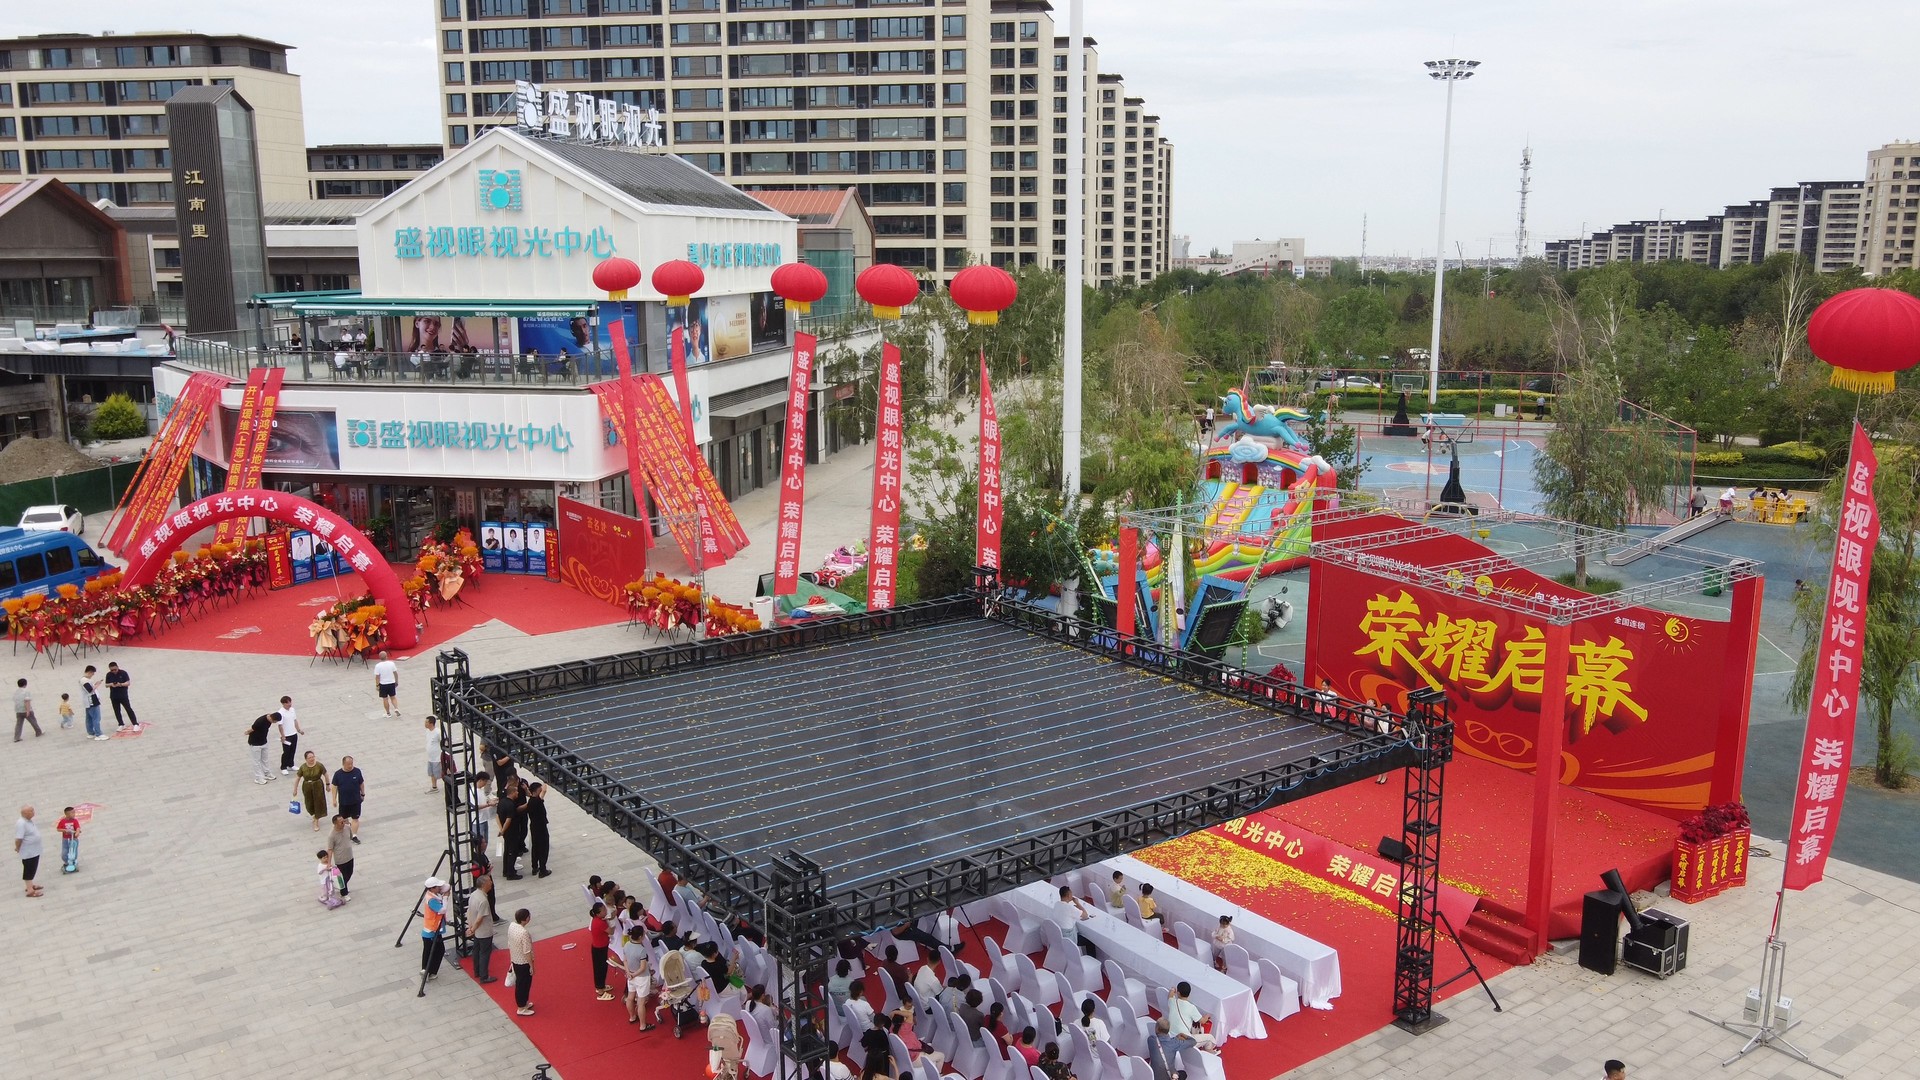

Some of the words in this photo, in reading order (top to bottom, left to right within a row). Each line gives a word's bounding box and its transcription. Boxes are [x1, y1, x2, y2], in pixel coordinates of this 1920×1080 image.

[548, 88, 663, 147] 盛视眼视光
[184, 170, 209, 238] 江南里
[393, 225, 618, 260] 盛视眼视光中心
[379, 419, 574, 453] 盛视眼视光中心
[786, 350, 810, 491] 盛视眼视光中心
[877, 363, 899, 513] 盛视眼视光中心
[140, 495, 279, 561] 盛视眼视光中心
[293, 505, 373, 573] 荣耀启幕
[778, 501, 800, 579] 荣耀启幕
[872, 524, 895, 609] 荣耀启幕
[1614, 616, 1646, 631] 全国连锁
[1821, 460, 1873, 719] 盛视眼视光中心
[1352, 589, 1649, 735] 荣耀启幕
[1217, 816, 1304, 859] 视光中心
[1796, 738, 1843, 866] 荣耀启幕
